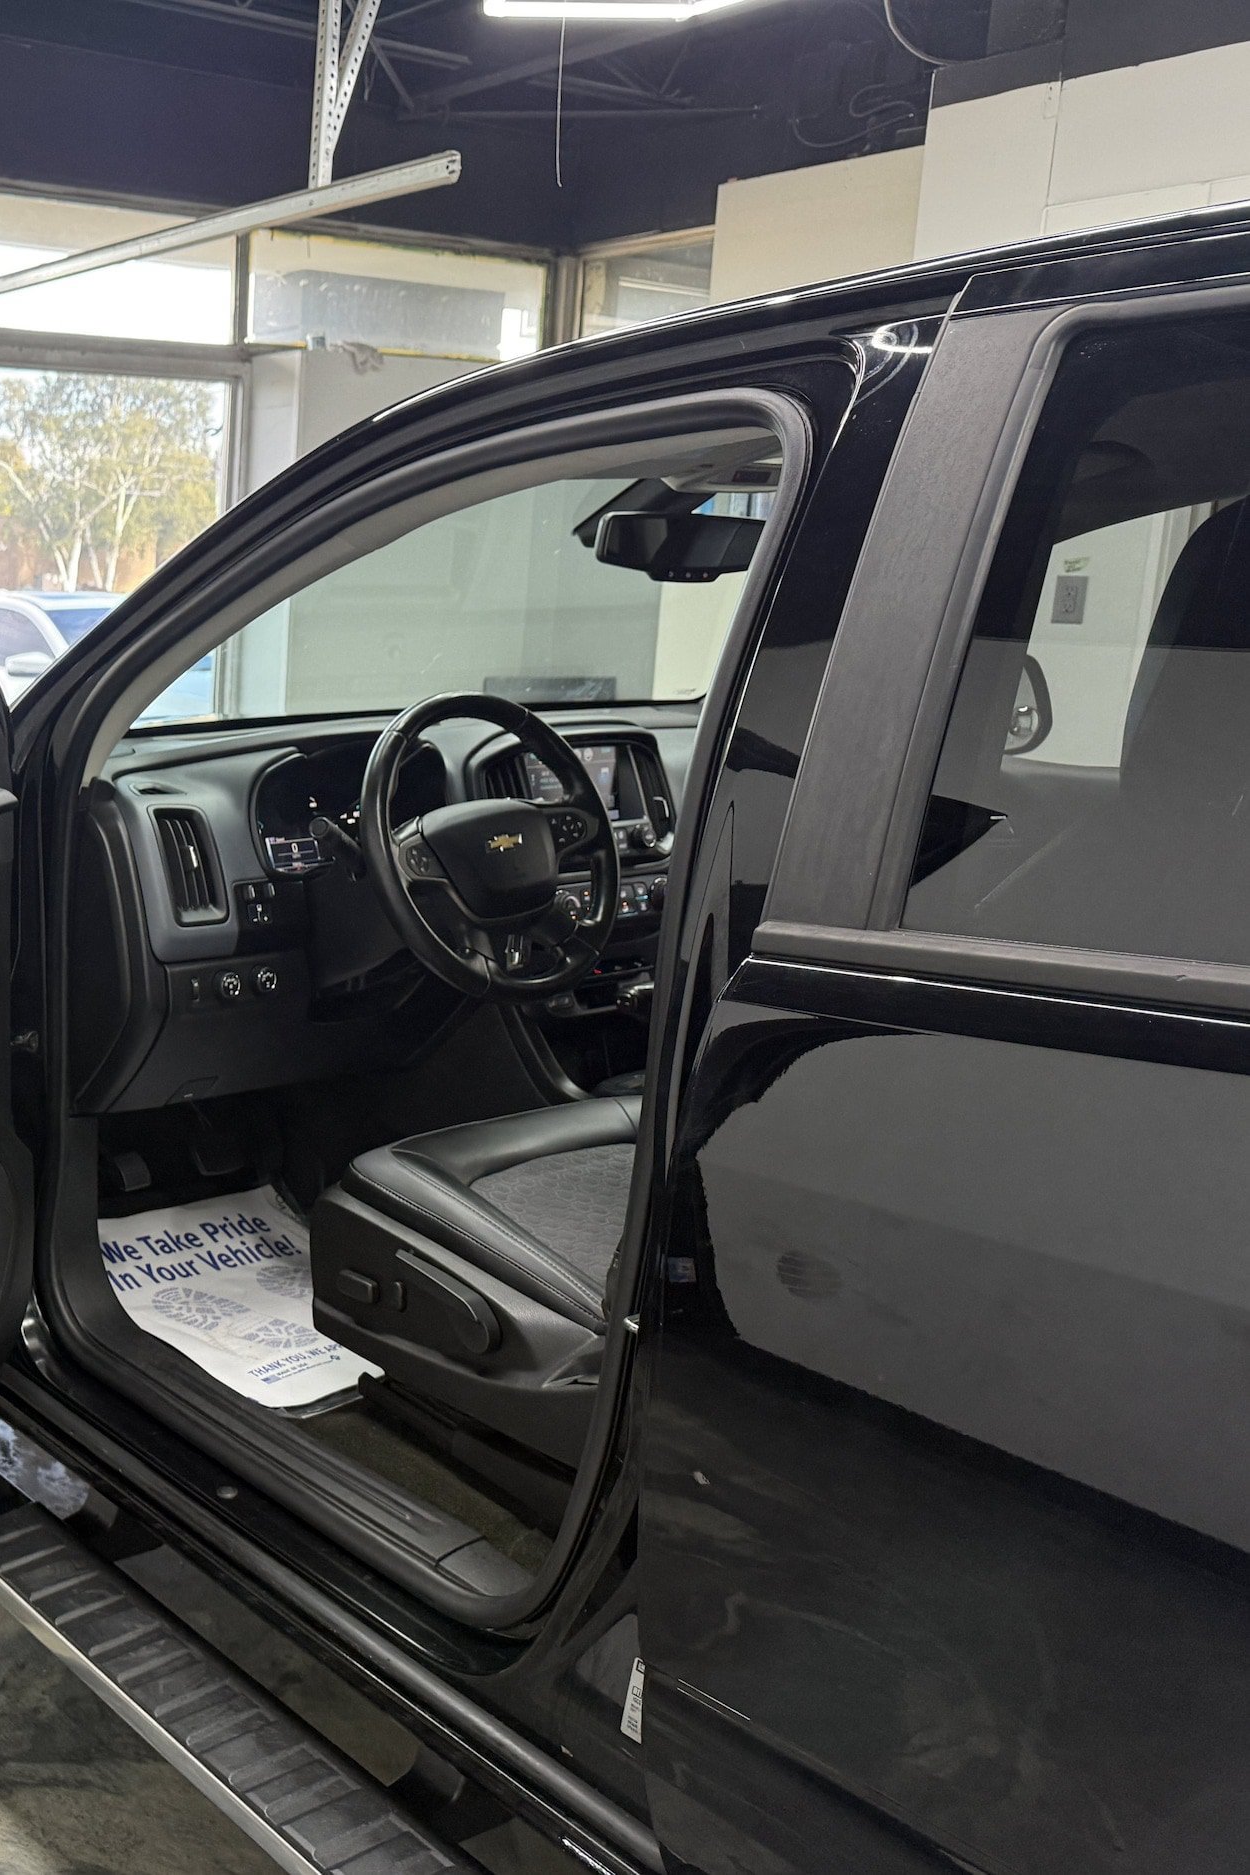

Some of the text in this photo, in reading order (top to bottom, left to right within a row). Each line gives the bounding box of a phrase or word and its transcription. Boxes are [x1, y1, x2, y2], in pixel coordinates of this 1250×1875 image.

[101, 1213, 272, 1265] We Take Pride
[106, 1234, 302, 1292] In Your Vehicle!
[248, 1358, 286, 1377] THANK
[284, 1351, 310, 1364] YOU,
[309, 1347, 325, 1359] WE
